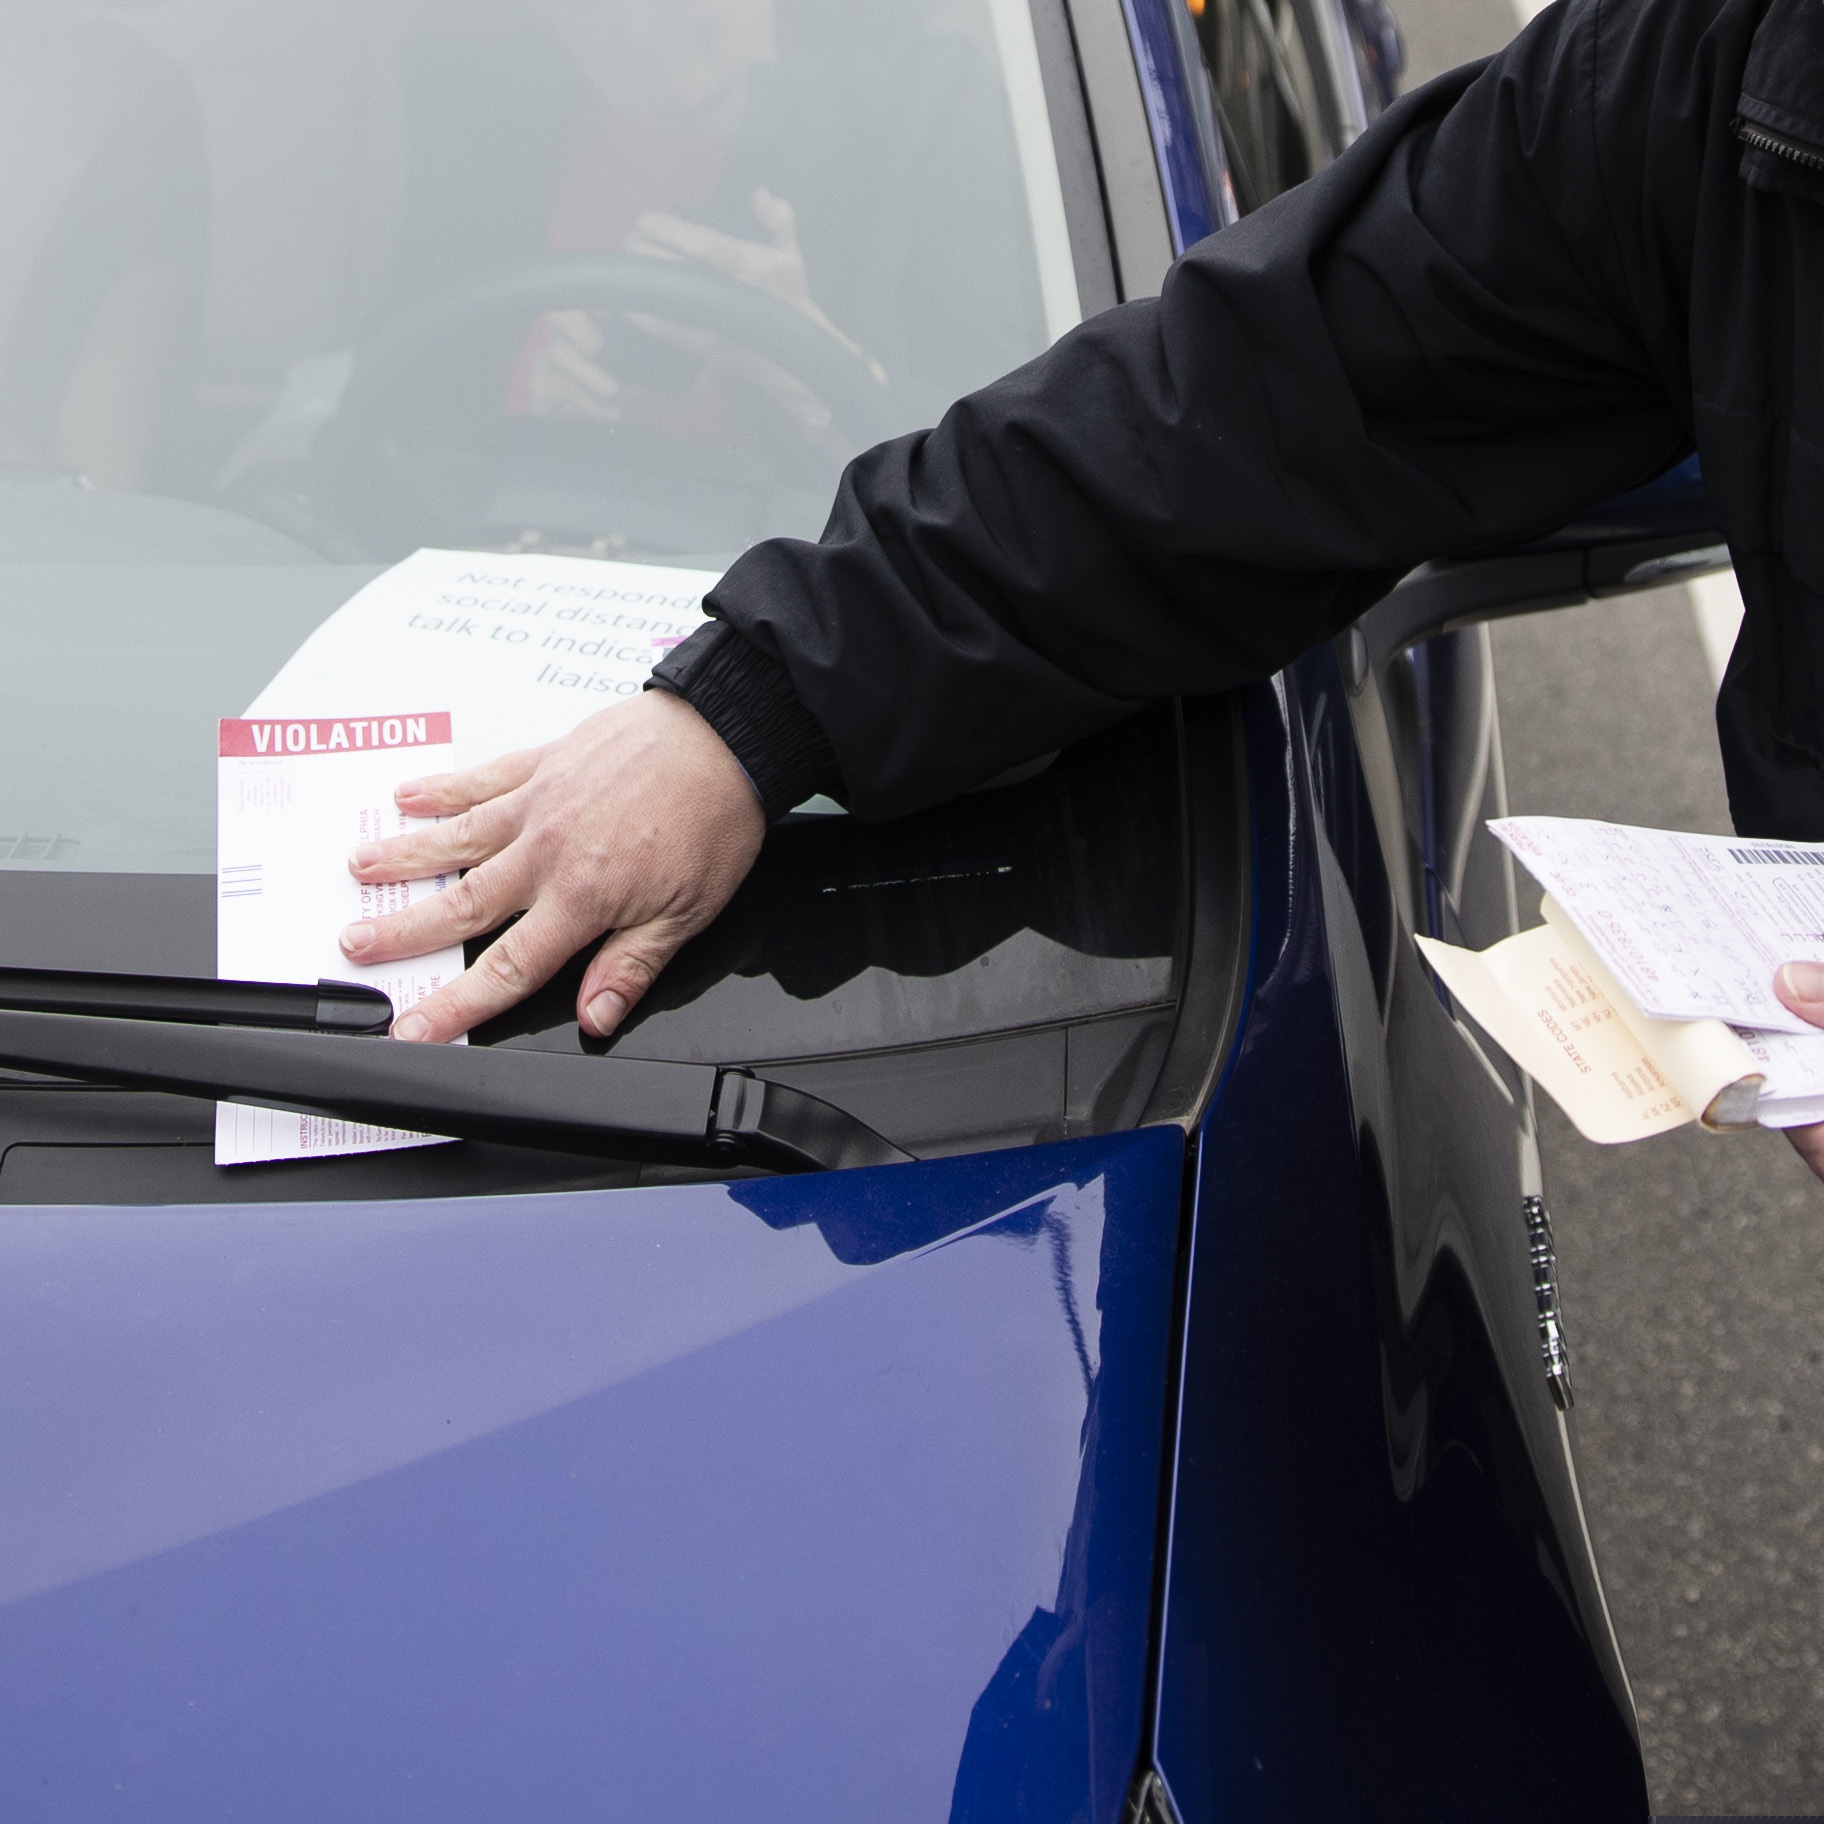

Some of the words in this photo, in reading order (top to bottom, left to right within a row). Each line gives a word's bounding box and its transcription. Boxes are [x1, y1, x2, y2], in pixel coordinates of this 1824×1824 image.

[457, 572, 528, 589] Not
[537, 580, 702, 610] respond
[434, 592, 547, 616] social
[555, 606, 697, 637] distanc
[407, 613, 482, 637] talk
[491, 623, 530, 644] to
[540, 630, 654, 664] indica
[535, 663, 642, 696] liaiso
[251, 717, 428, 754] VIOLATION
[1537, 1009, 1568, 1043] CODES
[1563, 1043, 1592, 1074] STATE
